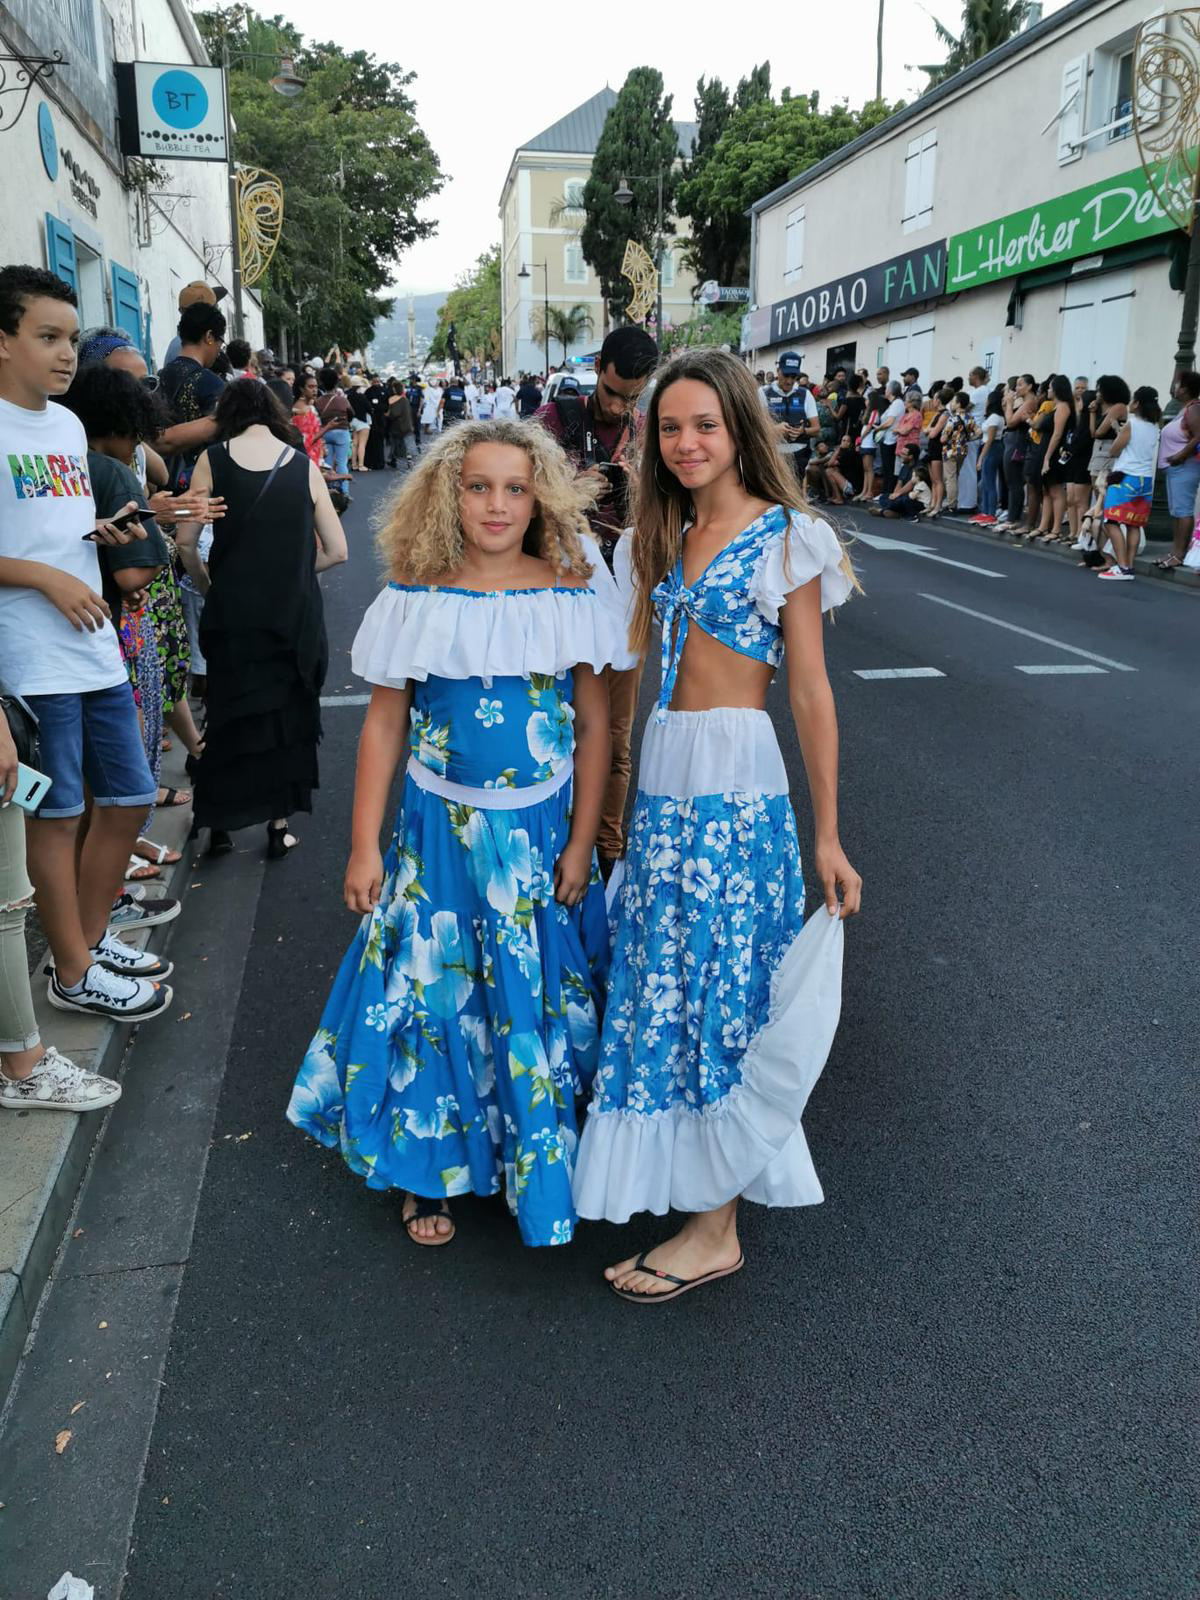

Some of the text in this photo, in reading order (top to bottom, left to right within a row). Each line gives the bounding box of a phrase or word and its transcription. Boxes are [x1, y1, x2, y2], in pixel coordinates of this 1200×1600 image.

[164, 90, 197, 112] BT
[154, 142, 211, 154] BUBBLE TEA
[951, 212, 1081, 284] L'Herbier
[775, 249, 942, 337] TAOBAO FAN
